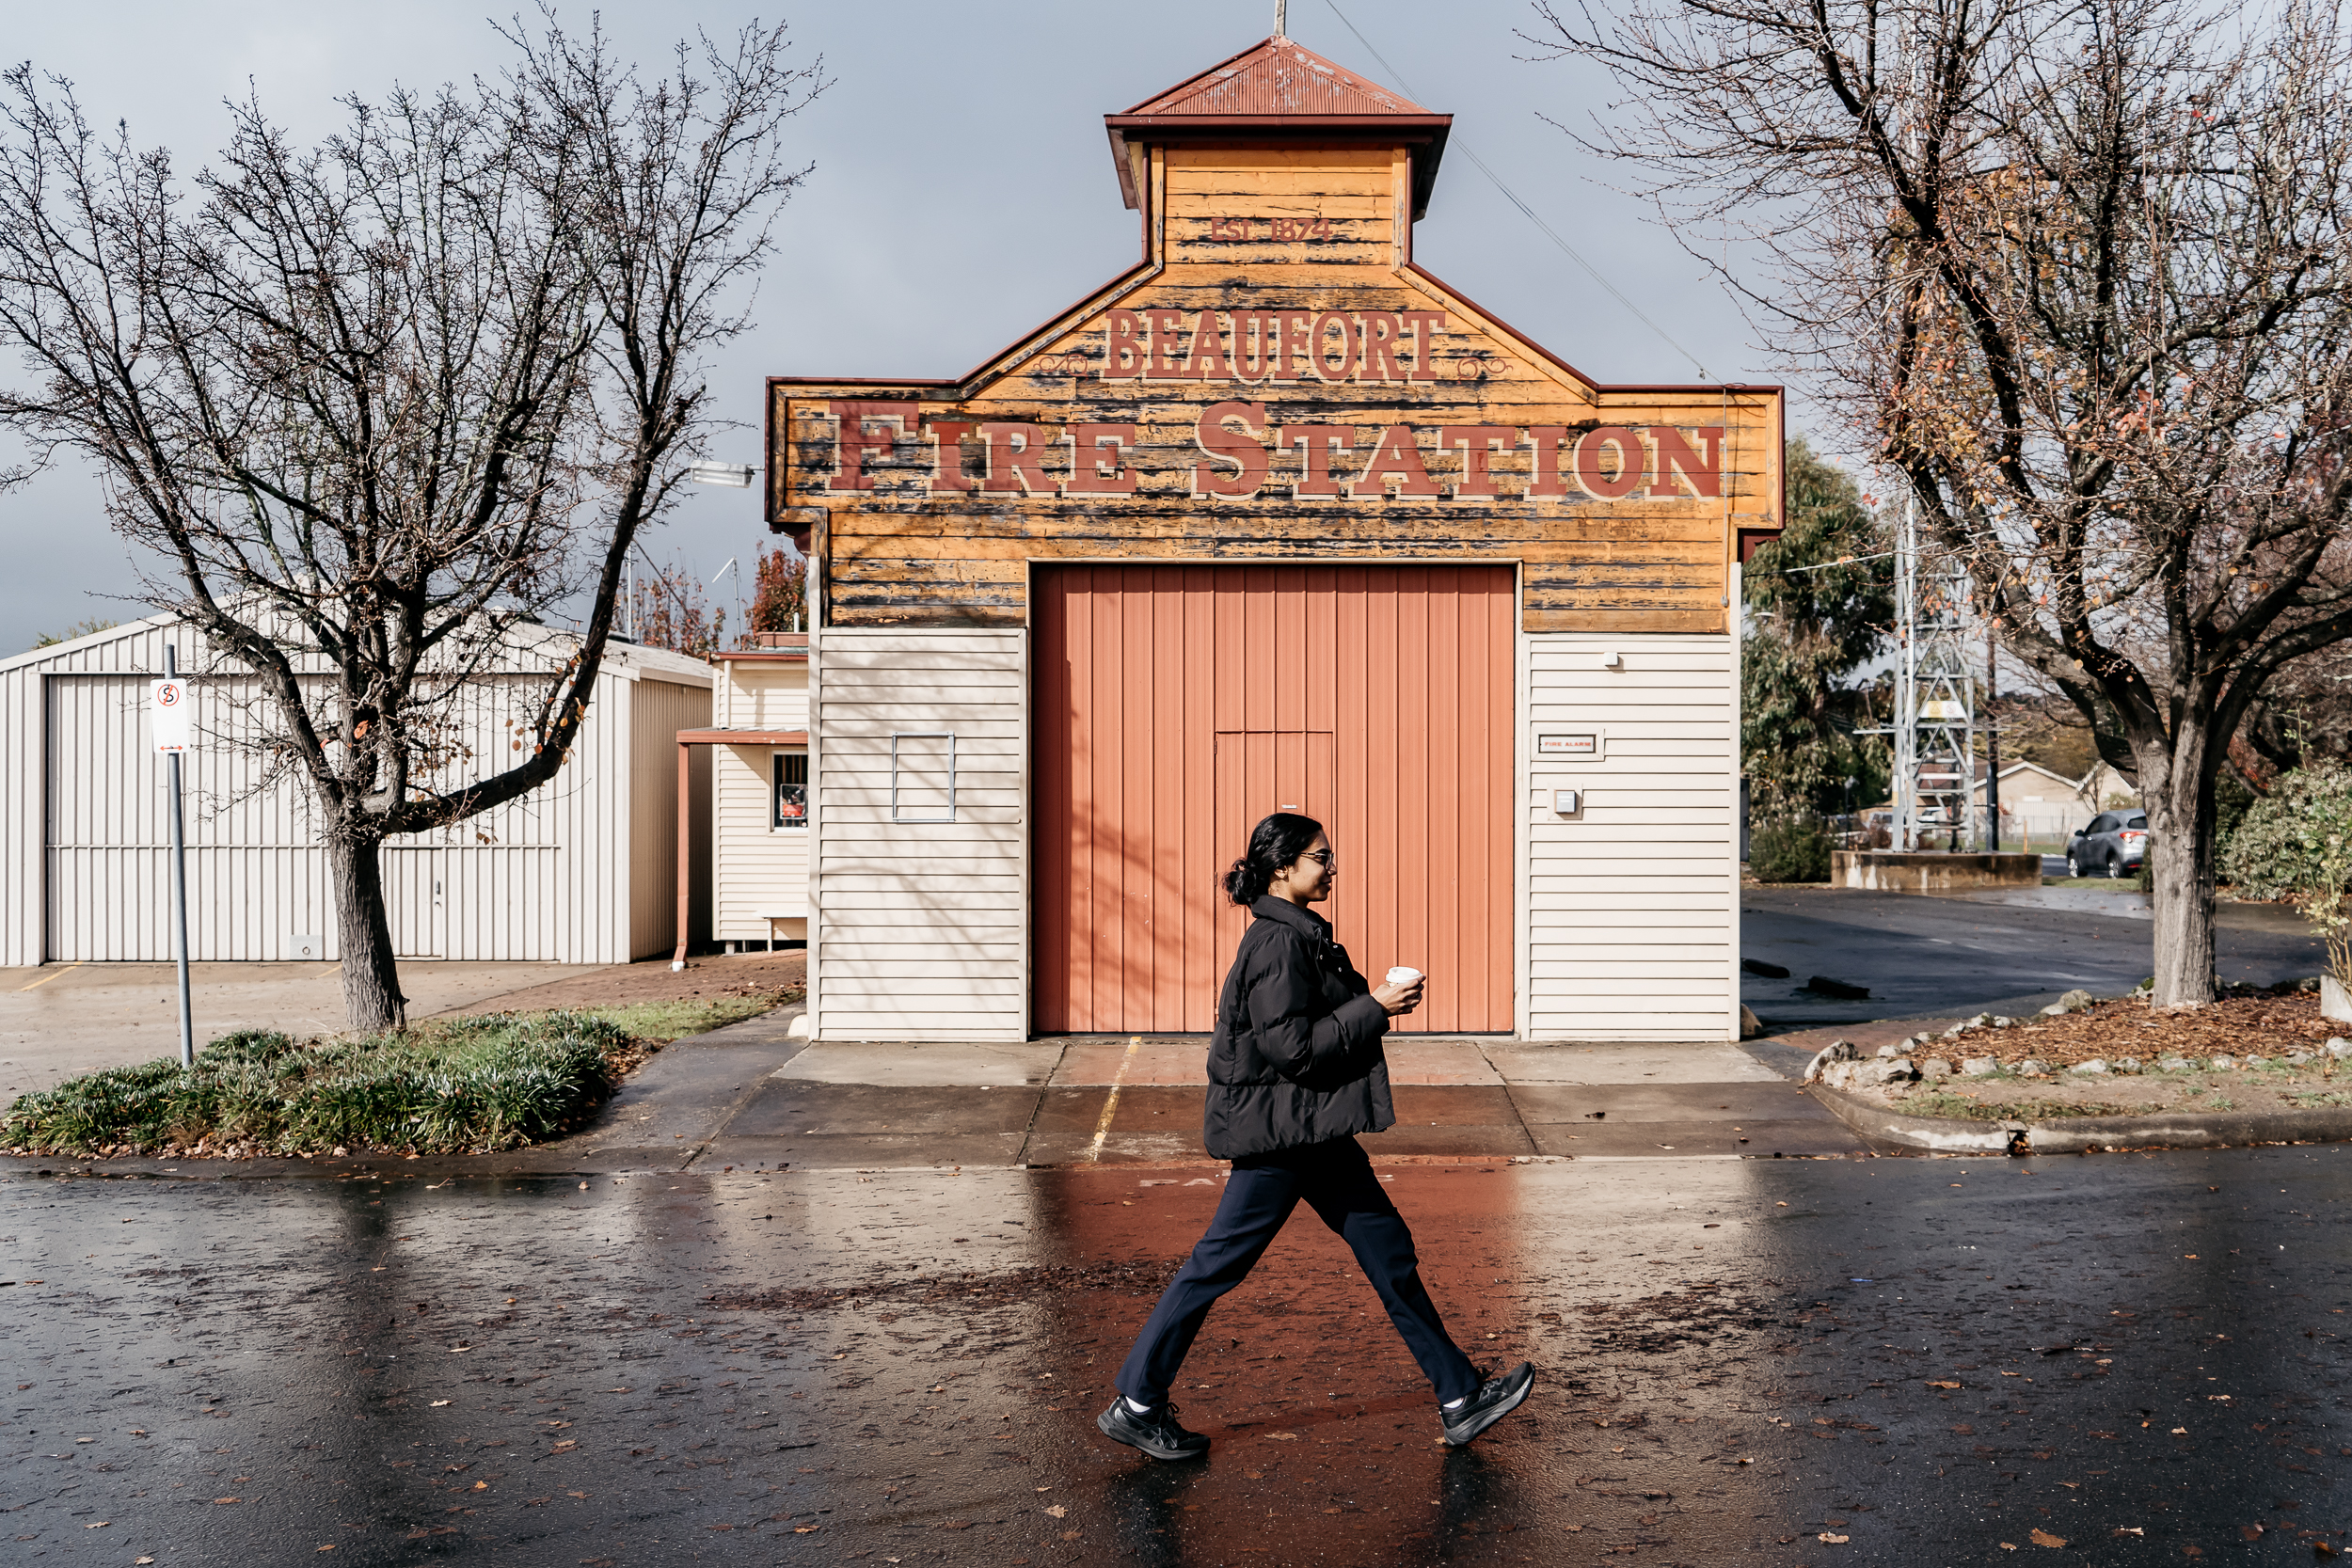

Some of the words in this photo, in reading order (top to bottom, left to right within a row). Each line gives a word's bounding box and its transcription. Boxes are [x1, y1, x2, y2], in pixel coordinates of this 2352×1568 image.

[1270, 217, 1333, 242] 1874
[1101, 309, 1447, 385] BEAUFORT
[824, 400, 1137, 499] FIRE
[1191, 402, 1724, 501] STATION
